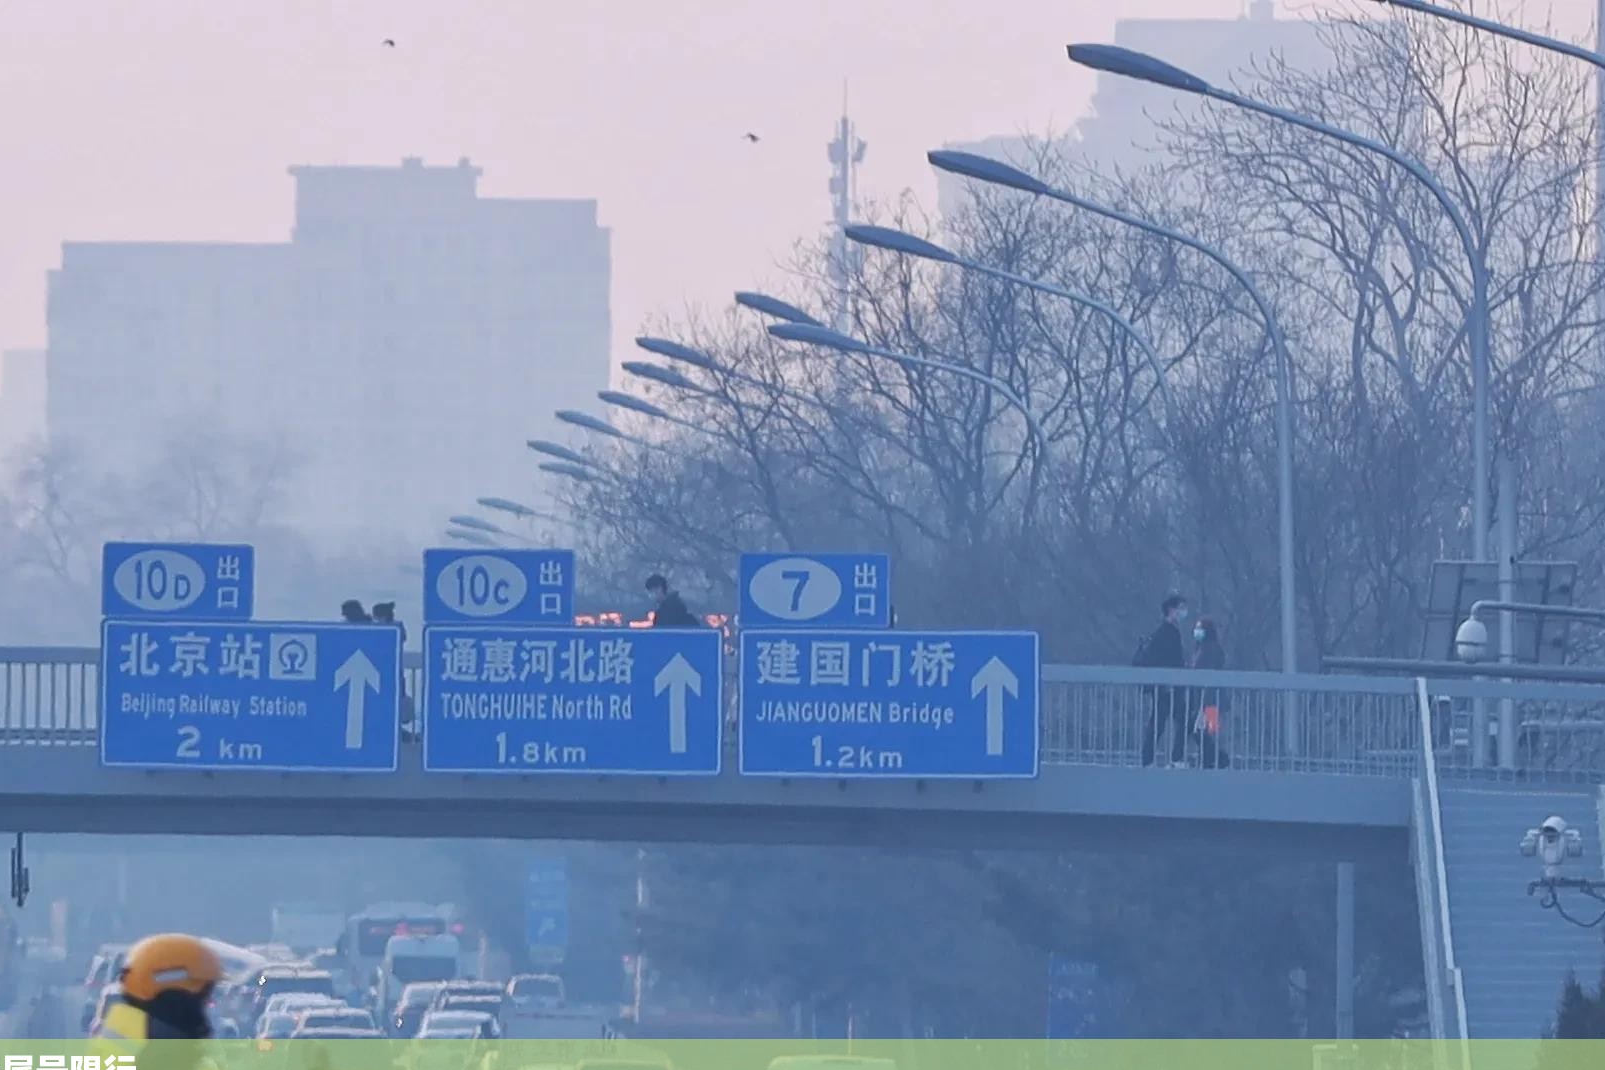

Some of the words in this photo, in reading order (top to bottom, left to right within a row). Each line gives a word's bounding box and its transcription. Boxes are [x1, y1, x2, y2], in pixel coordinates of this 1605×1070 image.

[134, 559, 191, 600] 10D
[217, 555, 240, 608] 出口
[456, 565, 509, 606] 10C
[539, 560, 562, 615] 出口
[781, 570, 810, 612] 7
[854, 562, 877, 616] 出口
[119, 631, 263, 680] 北京站
[441, 637, 635, 685] 通惠河北路
[756, 639, 956, 687] 建国门桥
[121, 693, 176, 720] Beijing
[179, 694, 241, 720] Railway
[249, 695, 308, 717] Station
[441, 693, 547, 720] TONGHUIHE
[552, 694, 604, 720] North
[609, 694, 632, 721] Rd
[756, 701, 882, 723] JIANGUOMEN
[889, 702, 954, 730] Bridge
[176, 725, 201, 758] 2
[219, 737, 263, 760] km
